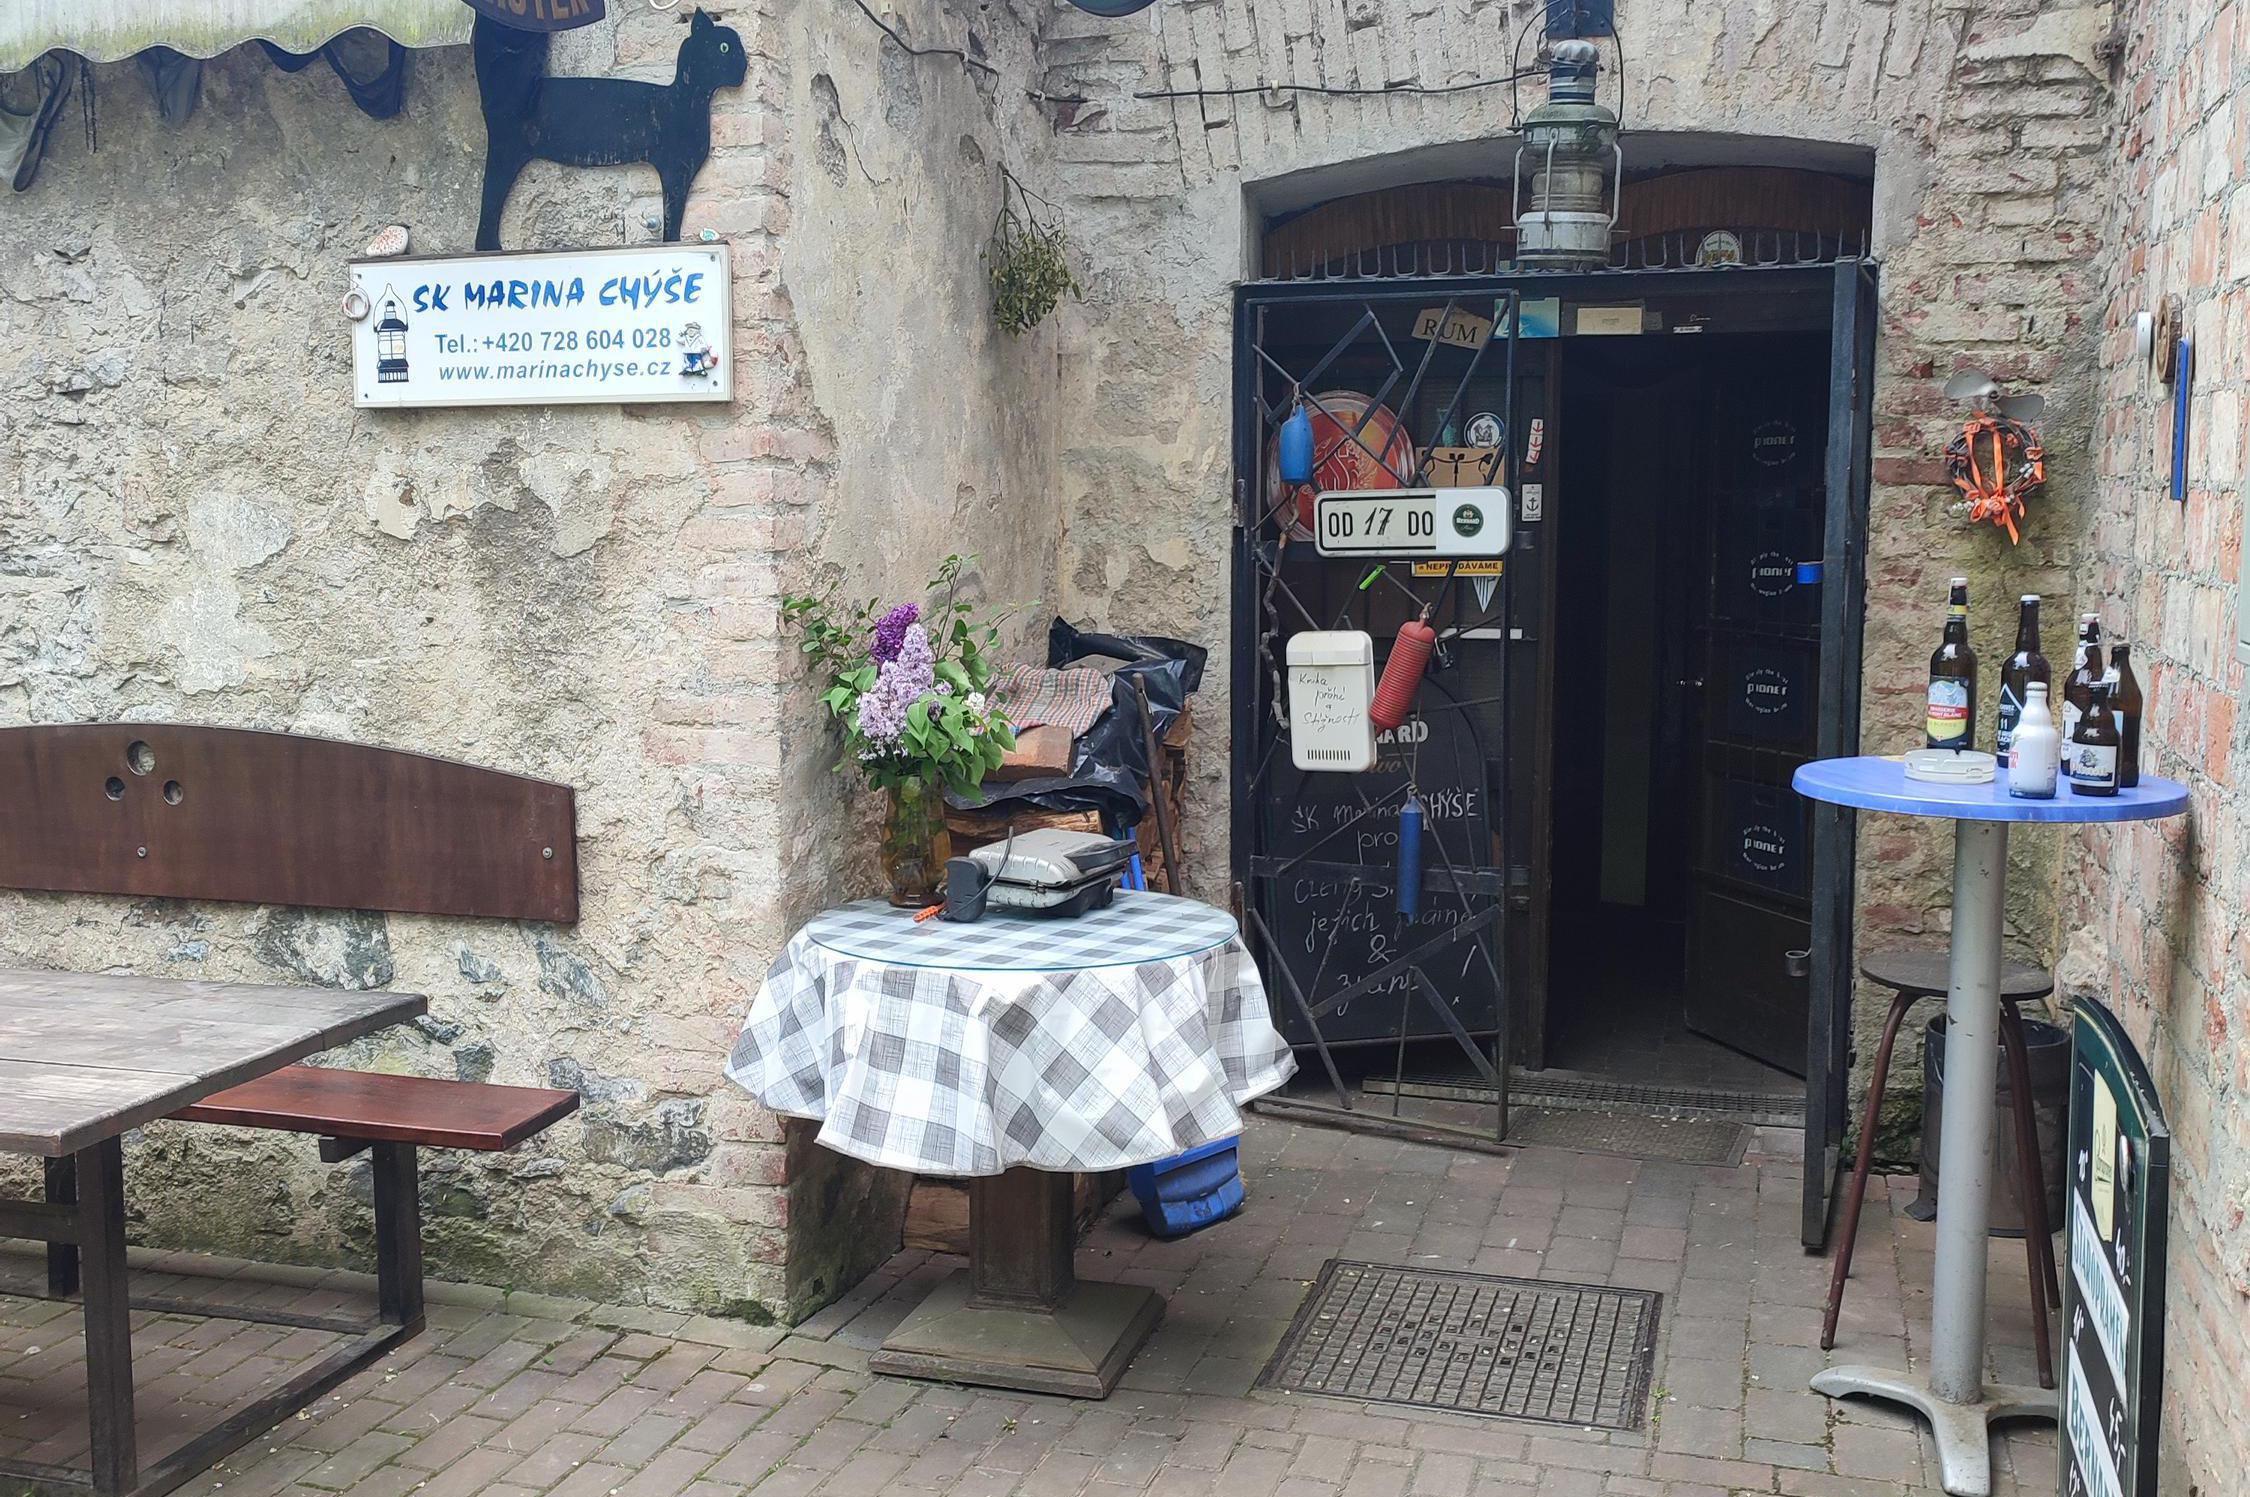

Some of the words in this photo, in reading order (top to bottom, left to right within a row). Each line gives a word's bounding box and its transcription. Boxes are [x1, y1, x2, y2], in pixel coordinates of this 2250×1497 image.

[412, 284, 451, 313] SK
[464, 277, 585, 311] MARINA
[599, 267, 705, 311] CHÝŠE
[435, 333, 478, 354] Tel.:
[482, 332, 533, 352] +420
[540, 331, 578, 350] 728
[586, 329, 624, 349] 604
[632, 328, 671, 348] 028
[1421, 318, 1479, 344] RUM
[439, 360, 671, 382] www.marinachyse.cz
[1328, 512, 1353, 537] OD
[1364, 507, 1394, 536] 17
[1408, 510, 1434, 536] DO
[1357, 830, 1399, 865] pro
[1368, 934, 1397, 963] &
